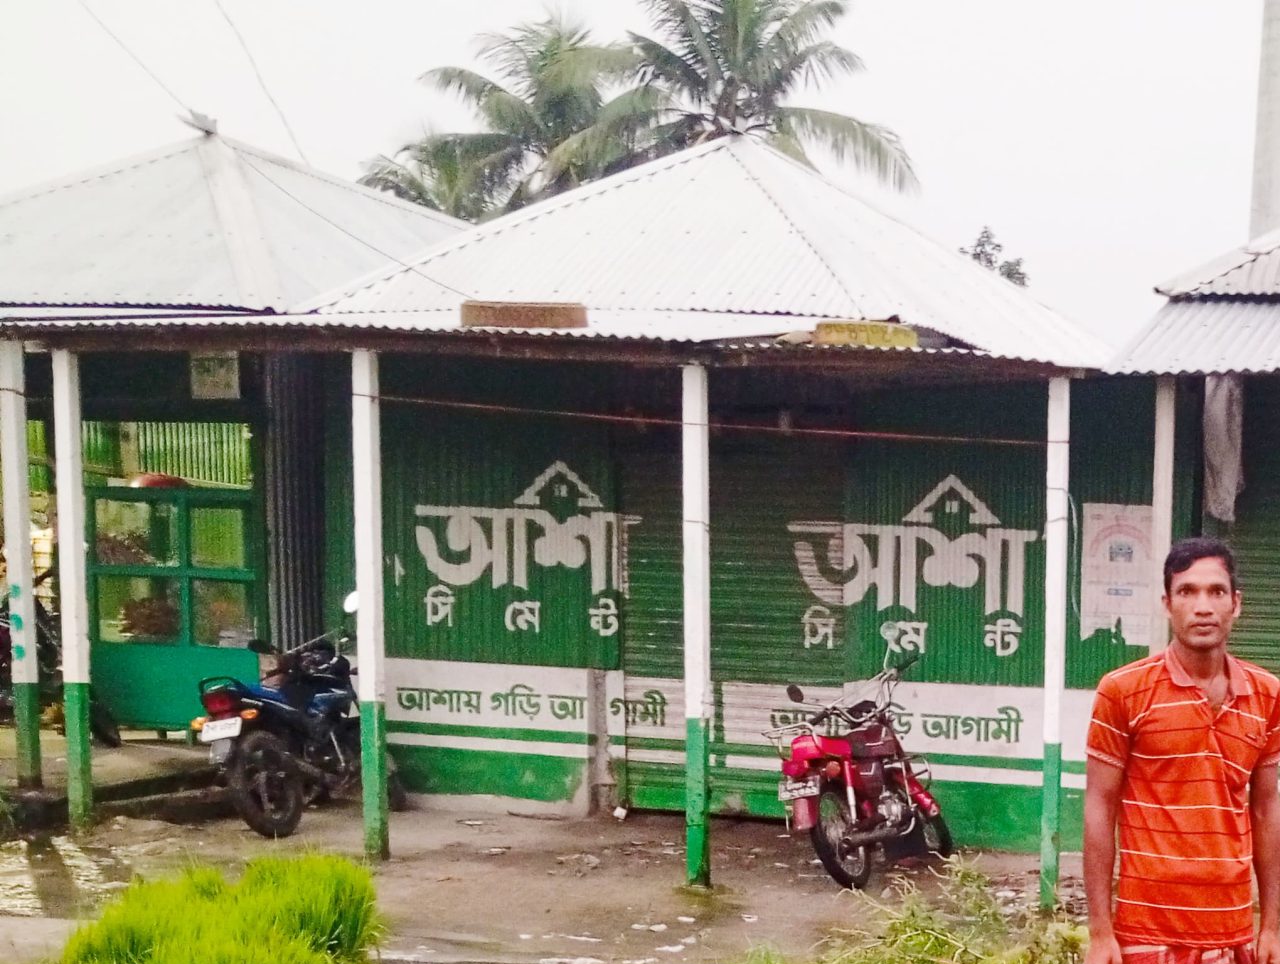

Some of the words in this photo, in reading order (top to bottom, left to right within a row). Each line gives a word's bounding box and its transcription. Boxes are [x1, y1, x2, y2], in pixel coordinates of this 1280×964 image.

[416, 504, 642, 599] আশা
[786, 521, 1038, 617] আশা
[396, 687, 482, 715] আশায়
[491, 684, 542, 721] গড়ি
[921, 706, 1024, 744] আগামী
